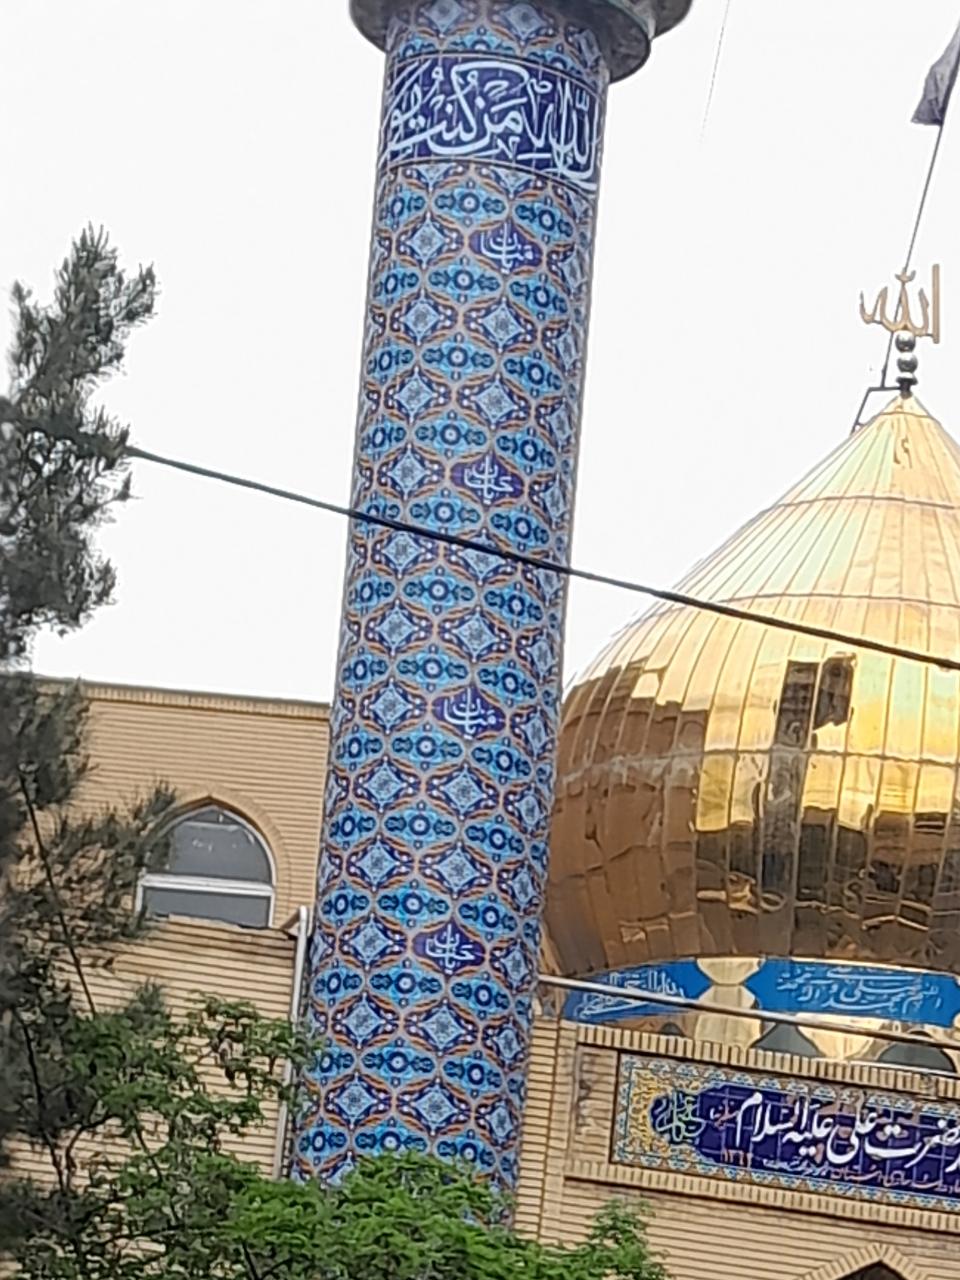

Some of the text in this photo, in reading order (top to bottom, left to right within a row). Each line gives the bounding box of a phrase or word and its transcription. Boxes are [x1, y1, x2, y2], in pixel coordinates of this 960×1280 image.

[735, 1091, 812, 1148] السلام
[781, 1103, 835, 1157] علیه
[826, 1093, 878, 1165] علی
